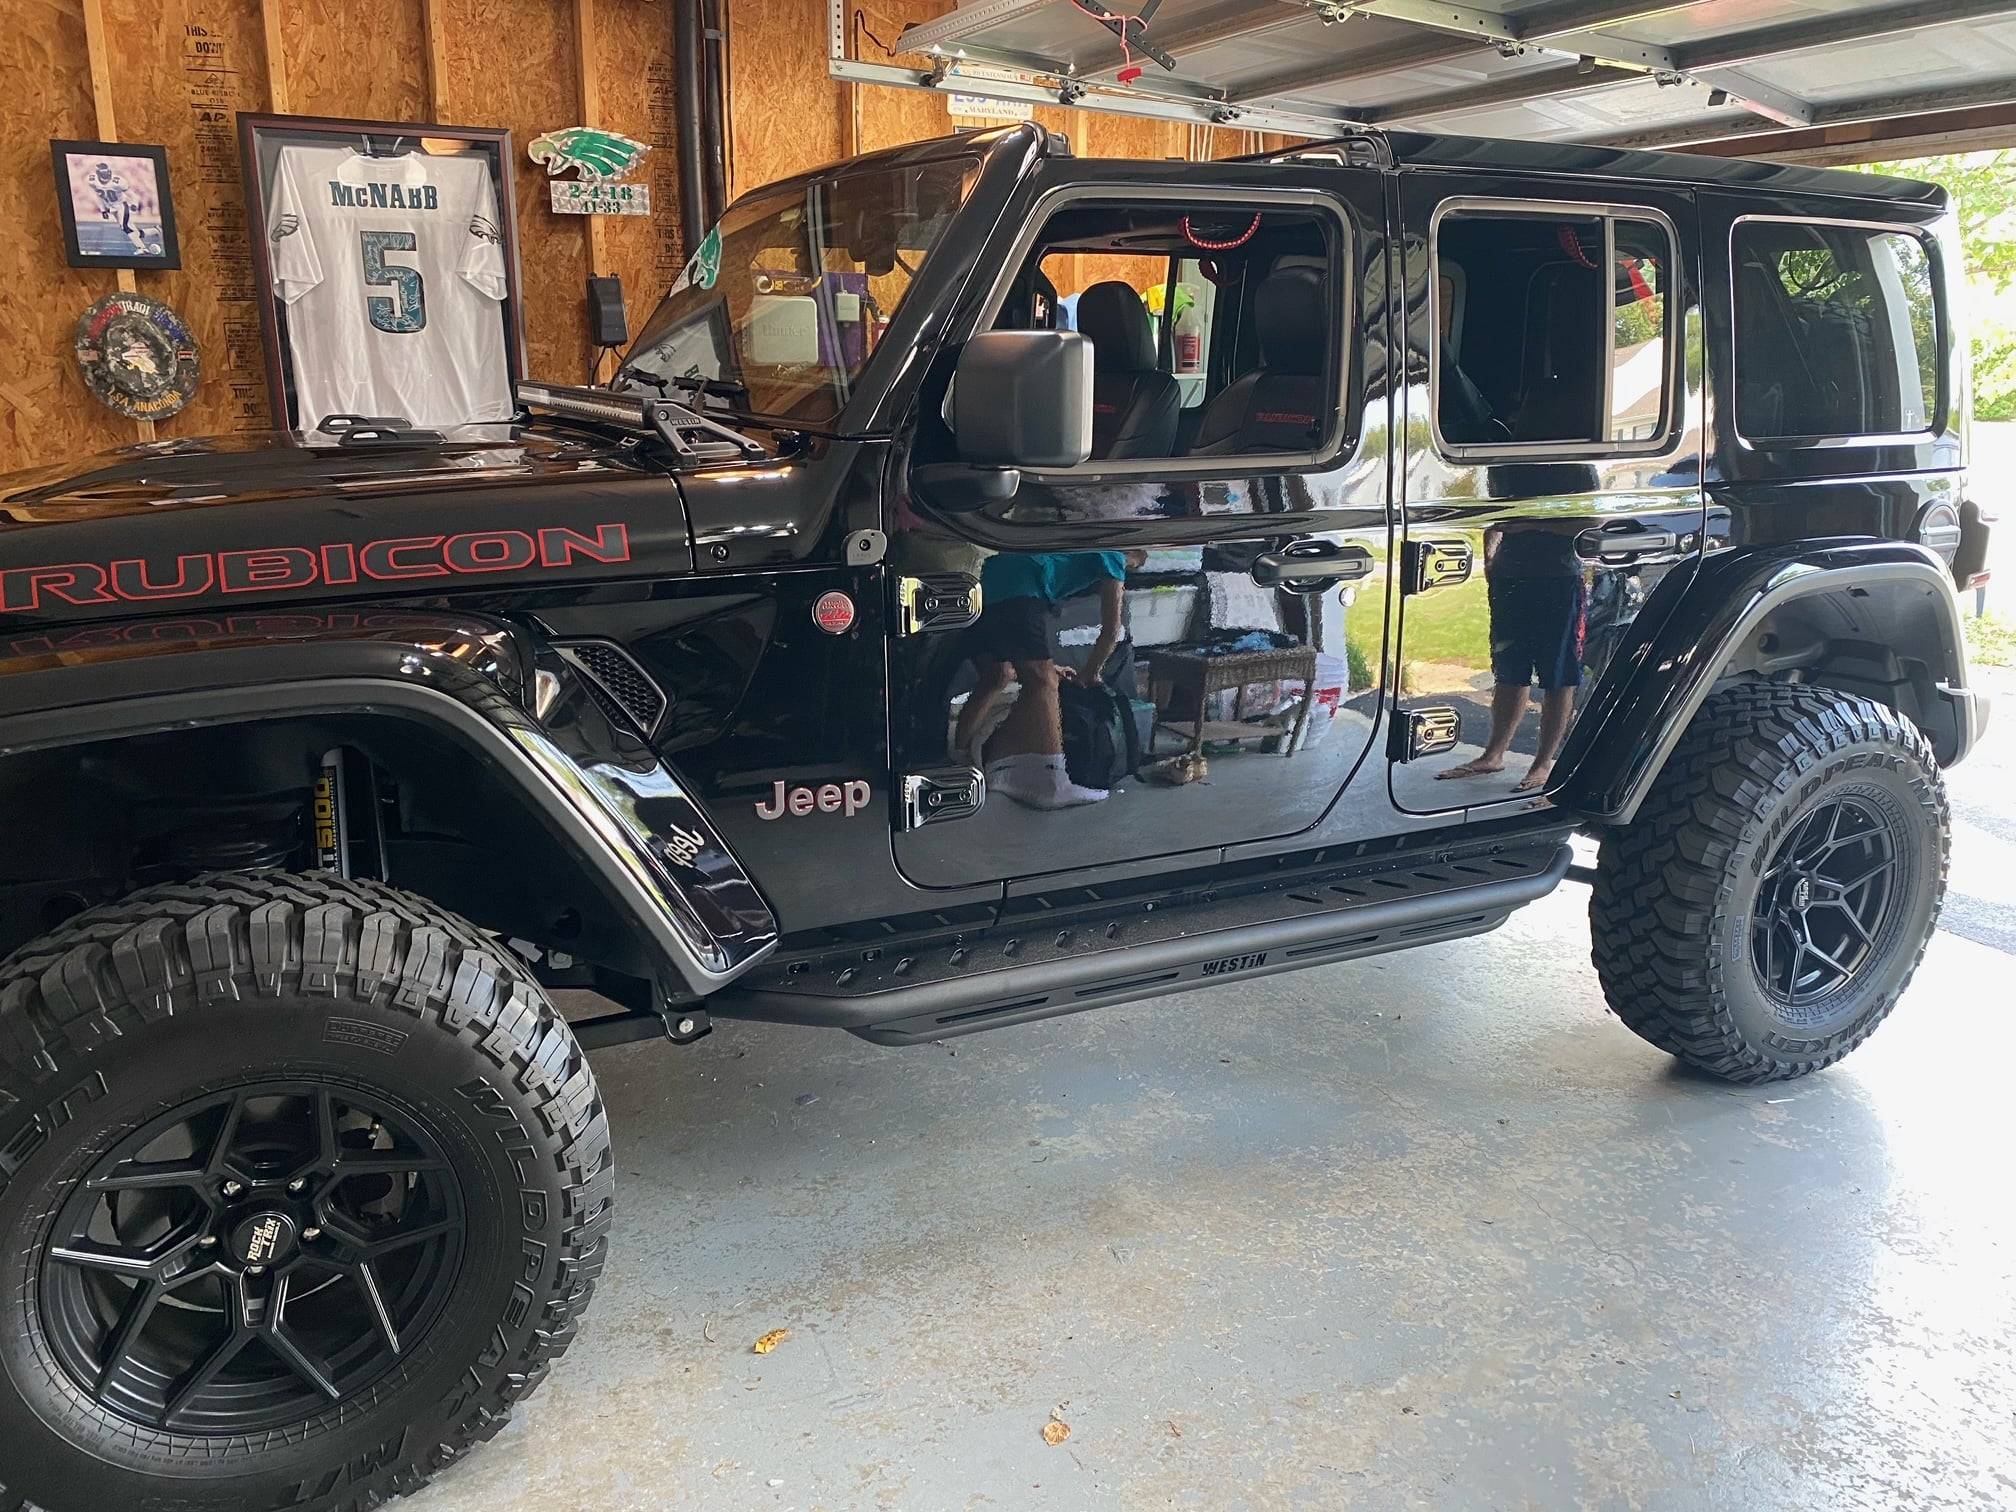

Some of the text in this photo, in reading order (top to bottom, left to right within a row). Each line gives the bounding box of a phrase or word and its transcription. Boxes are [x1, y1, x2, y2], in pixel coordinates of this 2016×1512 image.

[569, 184, 633, 200] 2-4-18
[360, 230, 427, 334] 5
[0, 524, 630, 612] RUBICON
[313, 776, 334, 849] 5100
[754, 779, 871, 821] Jeep
[246, 1225, 265, 1261] ROCK
